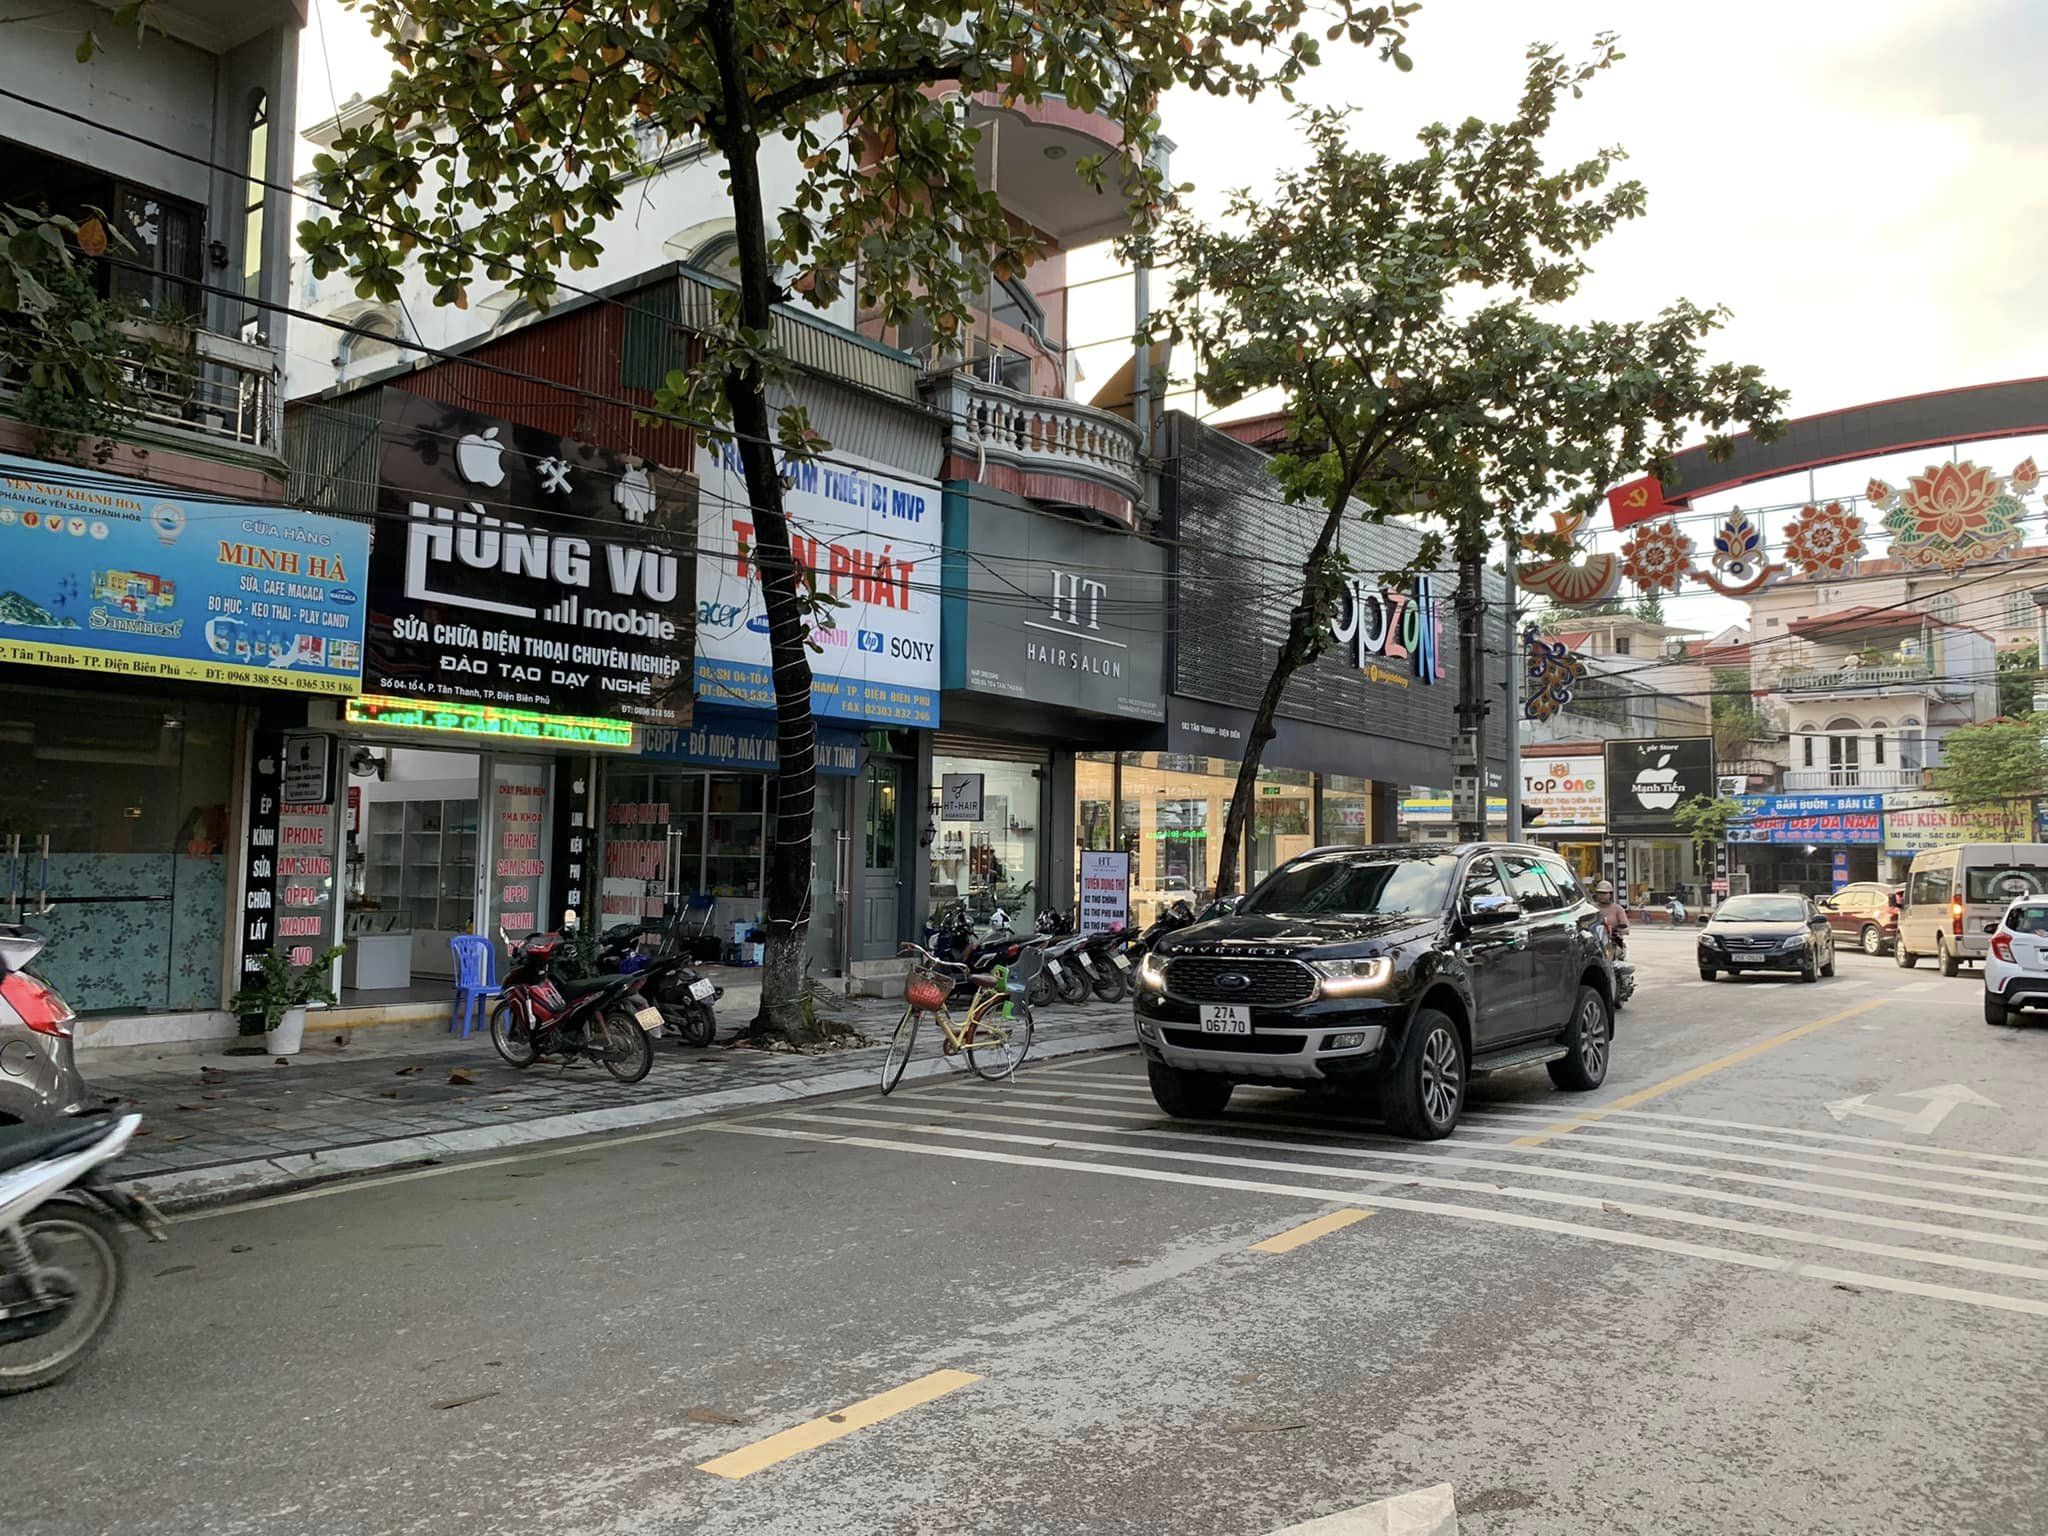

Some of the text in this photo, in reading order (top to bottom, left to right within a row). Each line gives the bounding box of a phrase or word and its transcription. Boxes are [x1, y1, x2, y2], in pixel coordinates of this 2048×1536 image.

[823, 468, 869, 507] THIẾT
[871, 483, 887, 519] BỊ
[892, 489, 925, 523] MVP
[284, 526, 331, 546] HÀNG
[218, 541, 348, 583] MINH HÀ
[404, 501, 592, 602] HÙNG
[829, 544, 915, 611] PHÁT
[263, 580, 286, 597] CAFE
[287, 583, 324, 602] MACACA
[1050, 569, 1107, 630] HT
[251, 601, 269, 620] KẸO
[299, 608, 320, 626] PLAY
[322, 612, 350, 629] CANDY
[583, 608, 676, 640] mobile
[698, 601, 741, 628] acer
[393, 614, 681, 678] SỬA CHỮA ĐIỆN THOẠI CHUYÊN NGHIỆP
[890, 636, 935, 662] SONY
[10, 647, 33, 661] Tân
[83, 655, 101, 668] TP.
[104, 657, 129, 672] Điện
[133, 660, 156, 673] Biên
[206, 668, 225, 681] ĐT:
[227, 671, 250, 683] 0968
[252, 673, 270, 684] 388
[271, 675, 288, 687] 554
[296, 678, 318, 690] 0365
[320, 680, 336, 692] 335
[338, 682, 353, 693] 186
[440, 653, 652, 695] ĐÀO TẠO DẠY NGHỀ
[428, 683, 436, 693] P.
[689, 724, 856, 769] ĐỔ MỰC MÁY IN TÍNH
[1524, 775, 1596, 793] Top one
[1631, 780, 1686, 794] Mạnh Tiến
[260, 794, 273, 814] ÉP
[944, 801, 978, 811] HT-HAIR
[1838, 797, 1860, 810] BÁN
[1820, 814, 1841, 830] DA
[1843, 814, 1879, 830] NAM
[1889, 813, 1913, 831] PHỤ
[1917, 809, 1946, 831] KIỆN
[253, 825, 275, 846] KÍNH
[283, 826, 325, 845] IPHONE
[253, 854, 271, 878] SỬA
[300, 857, 331, 876] SUNG
[1098, 857, 1112, 866] HT
[247, 887, 272, 909] CHỮA
[285, 887, 317, 907] OPPO
[504, 885, 529, 903] OPPO
[250, 916, 267, 940] LẤY
[279, 916, 321, 937] XIAOMI
[1213, 1006, 1236, 1019] 27A
[1206, 1019, 1246, 1033] 067.70
